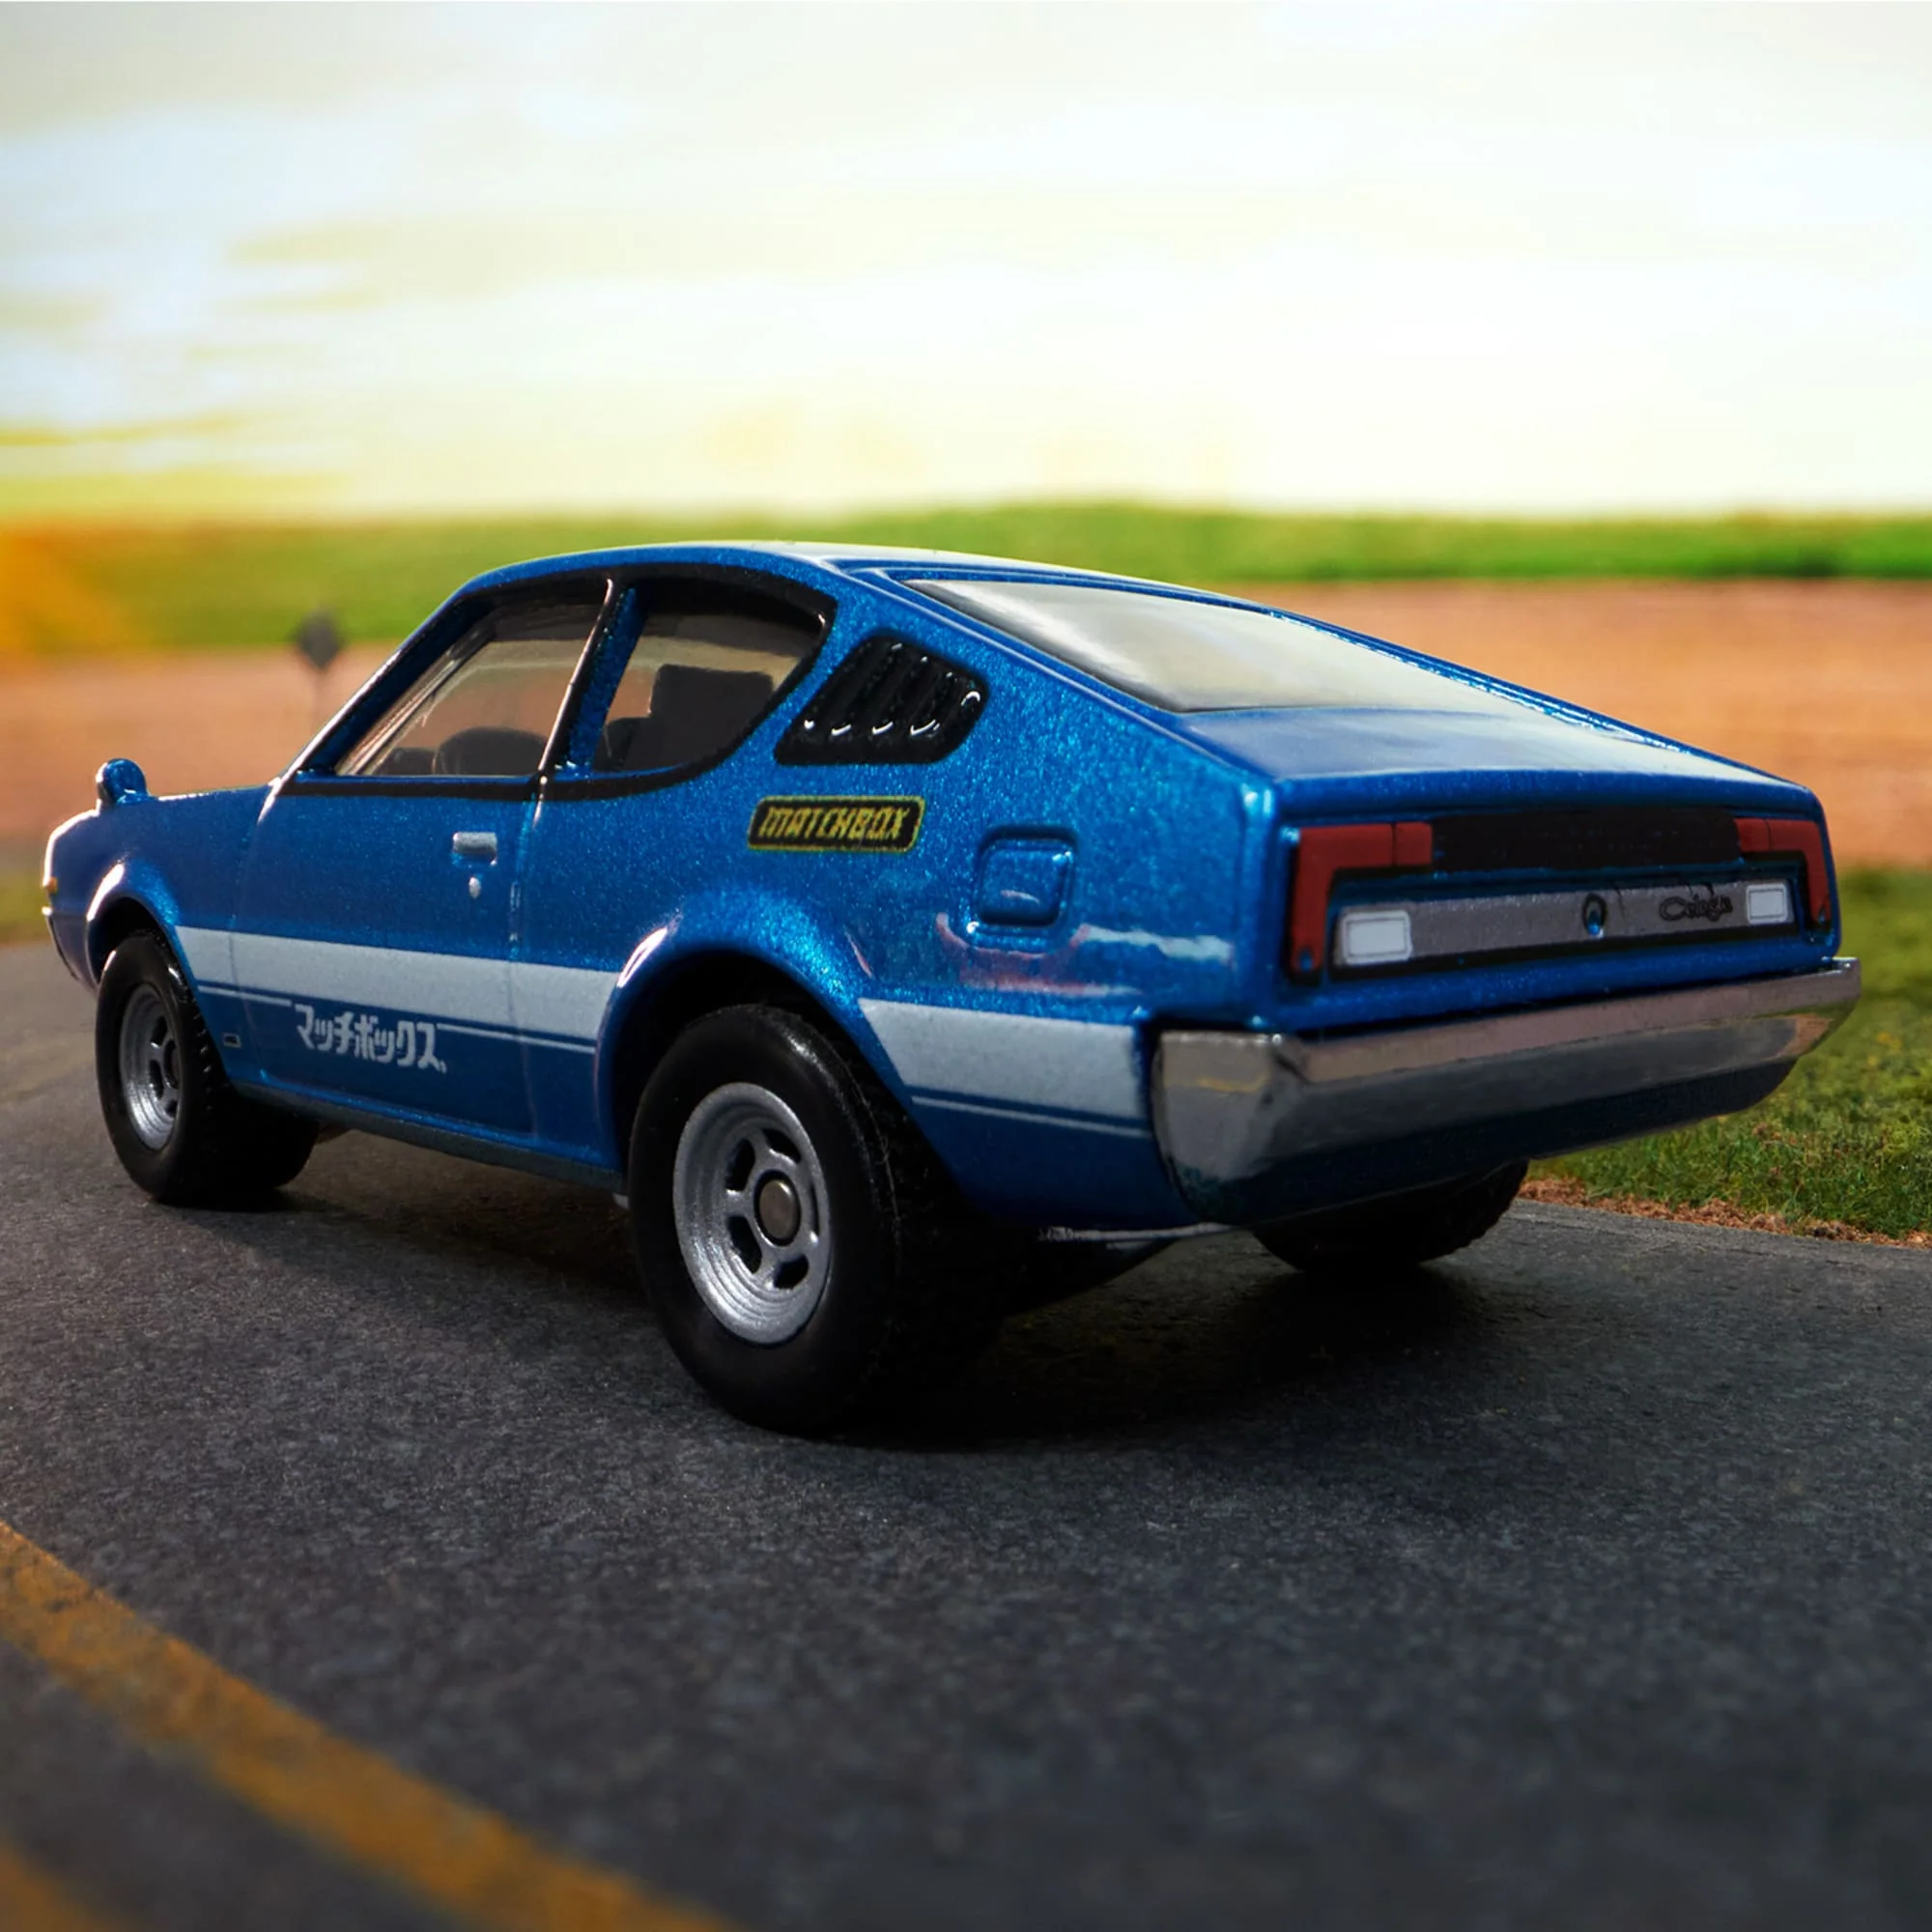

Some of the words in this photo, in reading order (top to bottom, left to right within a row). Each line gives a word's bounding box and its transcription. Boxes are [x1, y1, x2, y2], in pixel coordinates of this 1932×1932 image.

[757, 806, 910, 840] MATCHBOX
[294, 1003, 445, 1071] マッチボックス
